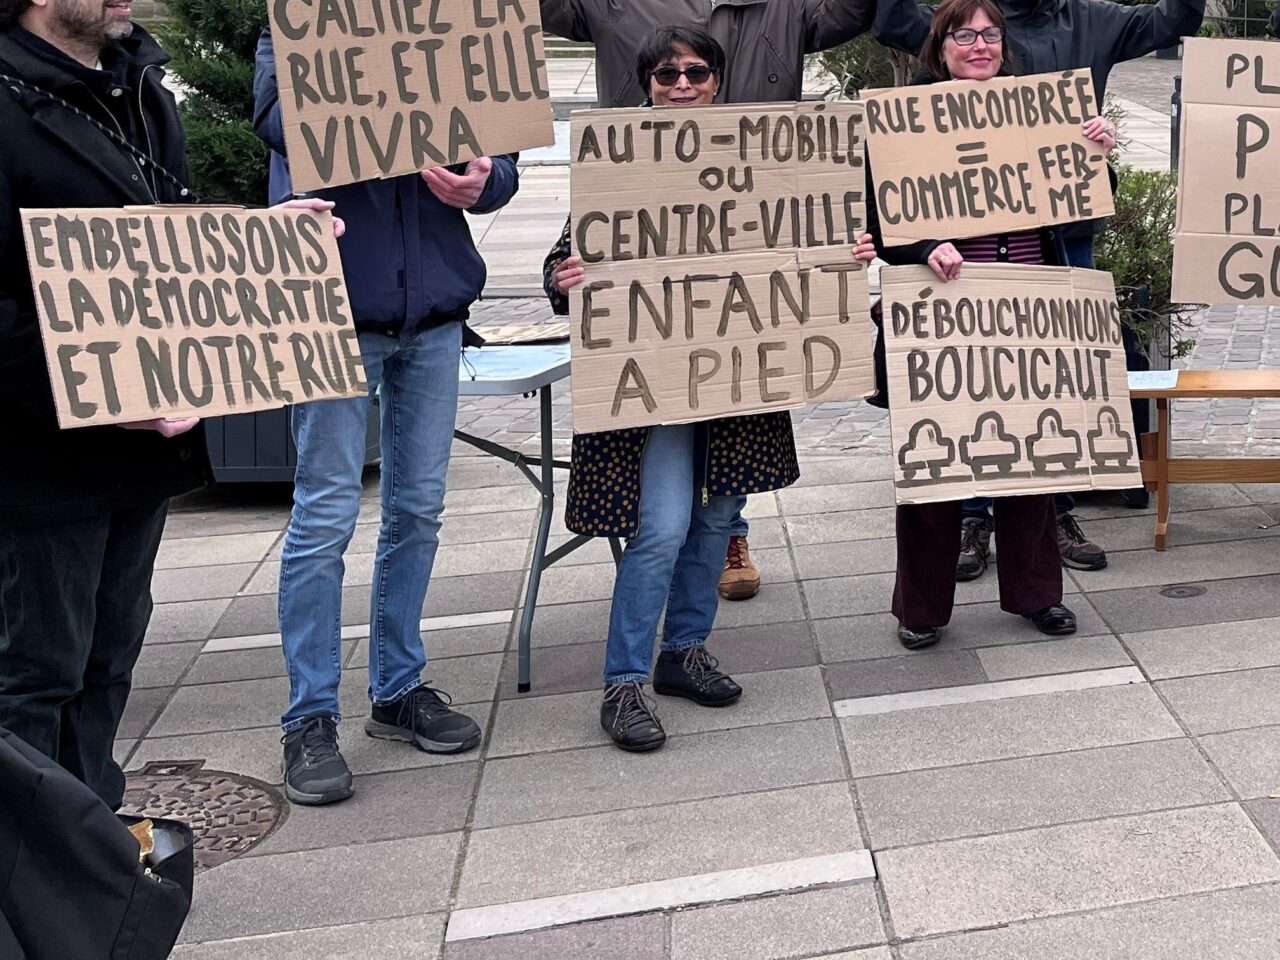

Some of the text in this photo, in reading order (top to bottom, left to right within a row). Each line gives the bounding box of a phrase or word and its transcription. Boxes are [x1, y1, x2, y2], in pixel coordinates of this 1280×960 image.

[286, 24, 550, 112] RUE, ET ELLE
[866, 70, 1096, 134] RUE ENCOMBRÉE
[300, 106, 483, 183] VIVRA
[878, 141, 1103, 225] COMMERCE FER-
[29, 212, 328, 276] EMBELLISSONS
[575, 191, 863, 263] CENTRE-VILLE
[39, 277, 105, 333] LA
[581, 262, 862, 350] ENFANT
[891, 286, 1121, 345] DÉBOUCHONNONS
[56, 328, 368, 419] ET NOTRE RUE
[610, 335, 842, 416] A PIED
[907, 345, 1111, 402] BOUCICAUT
